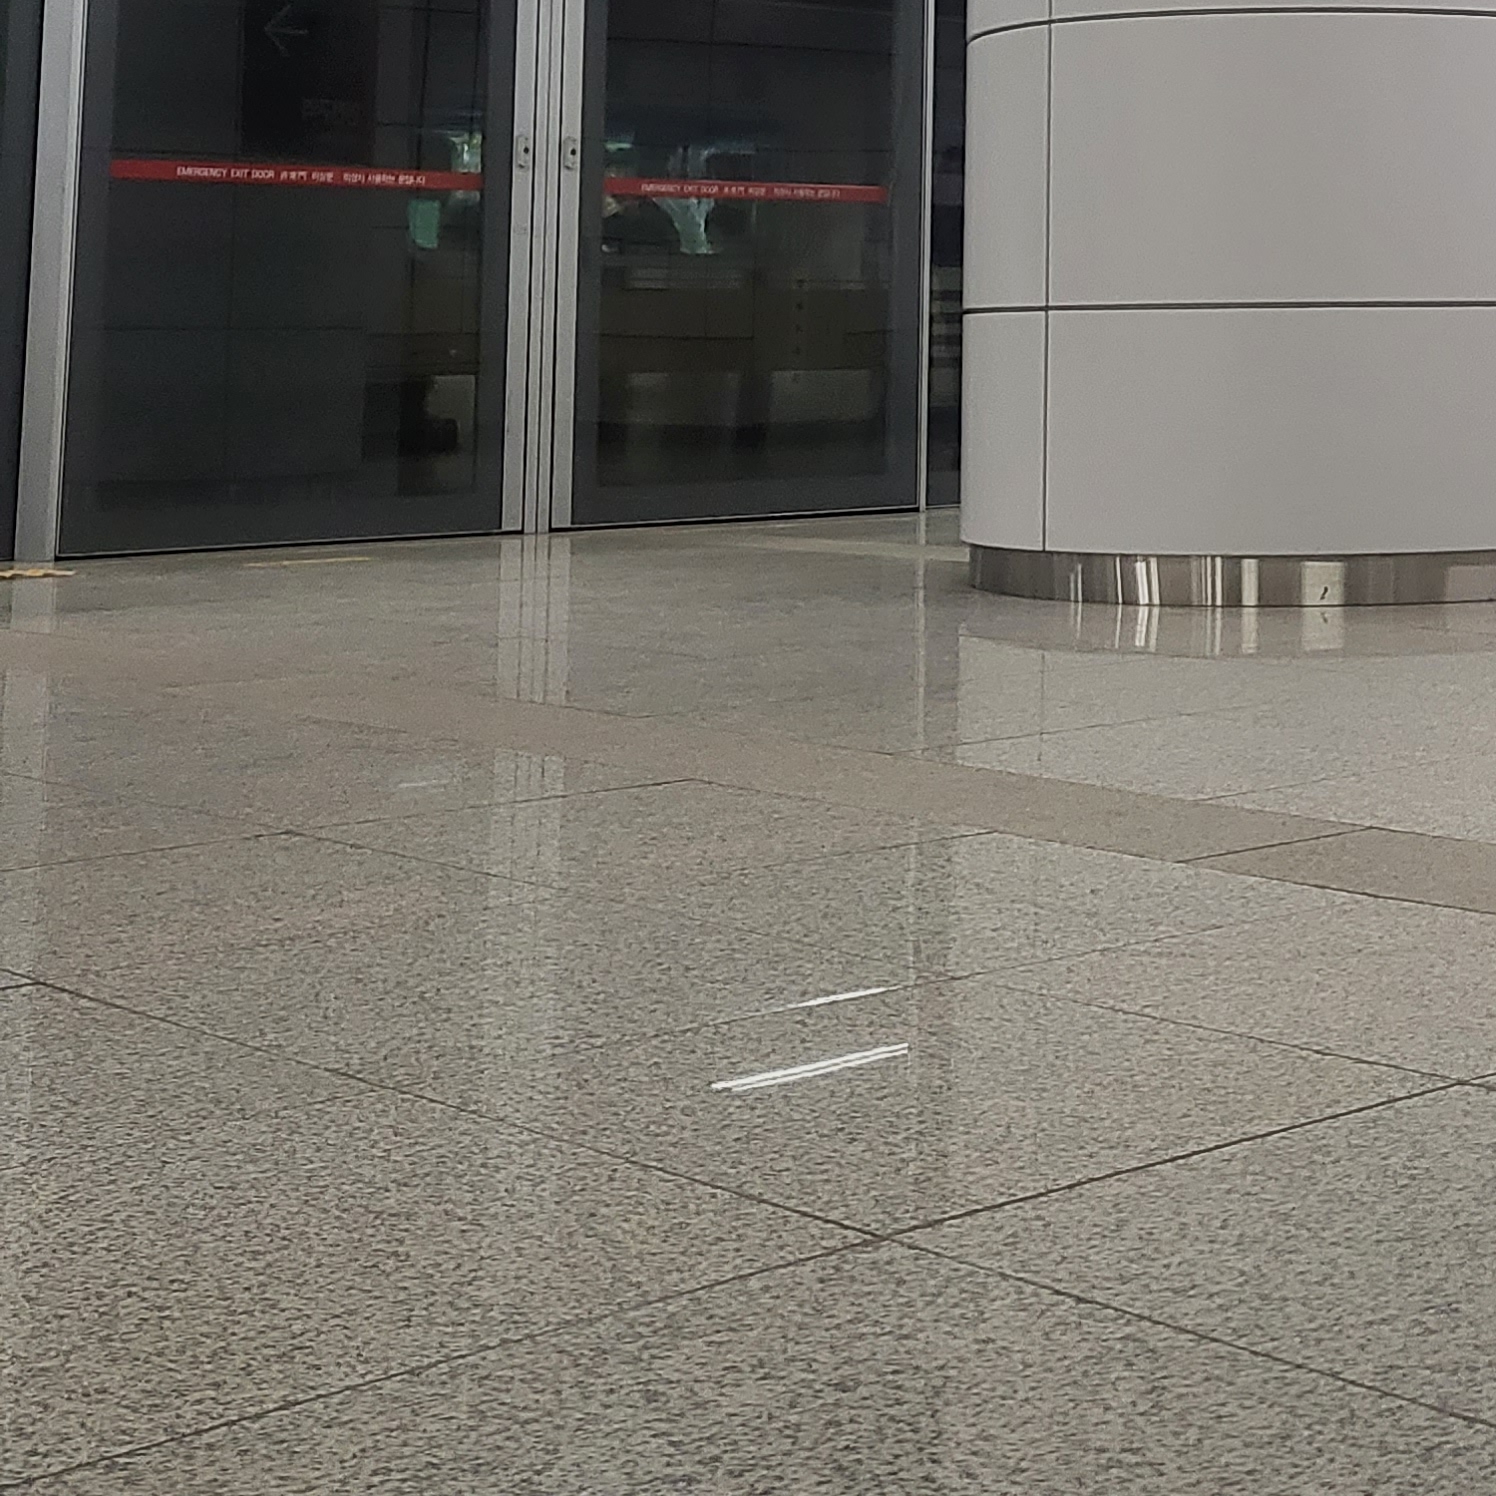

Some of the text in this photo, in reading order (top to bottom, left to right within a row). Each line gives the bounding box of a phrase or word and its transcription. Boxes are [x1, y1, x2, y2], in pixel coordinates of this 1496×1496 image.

[177, 166, 228, 178] EMERGENCY
[230, 168, 250, 178] EXIT
[251, 169, 275, 179] DOOR
